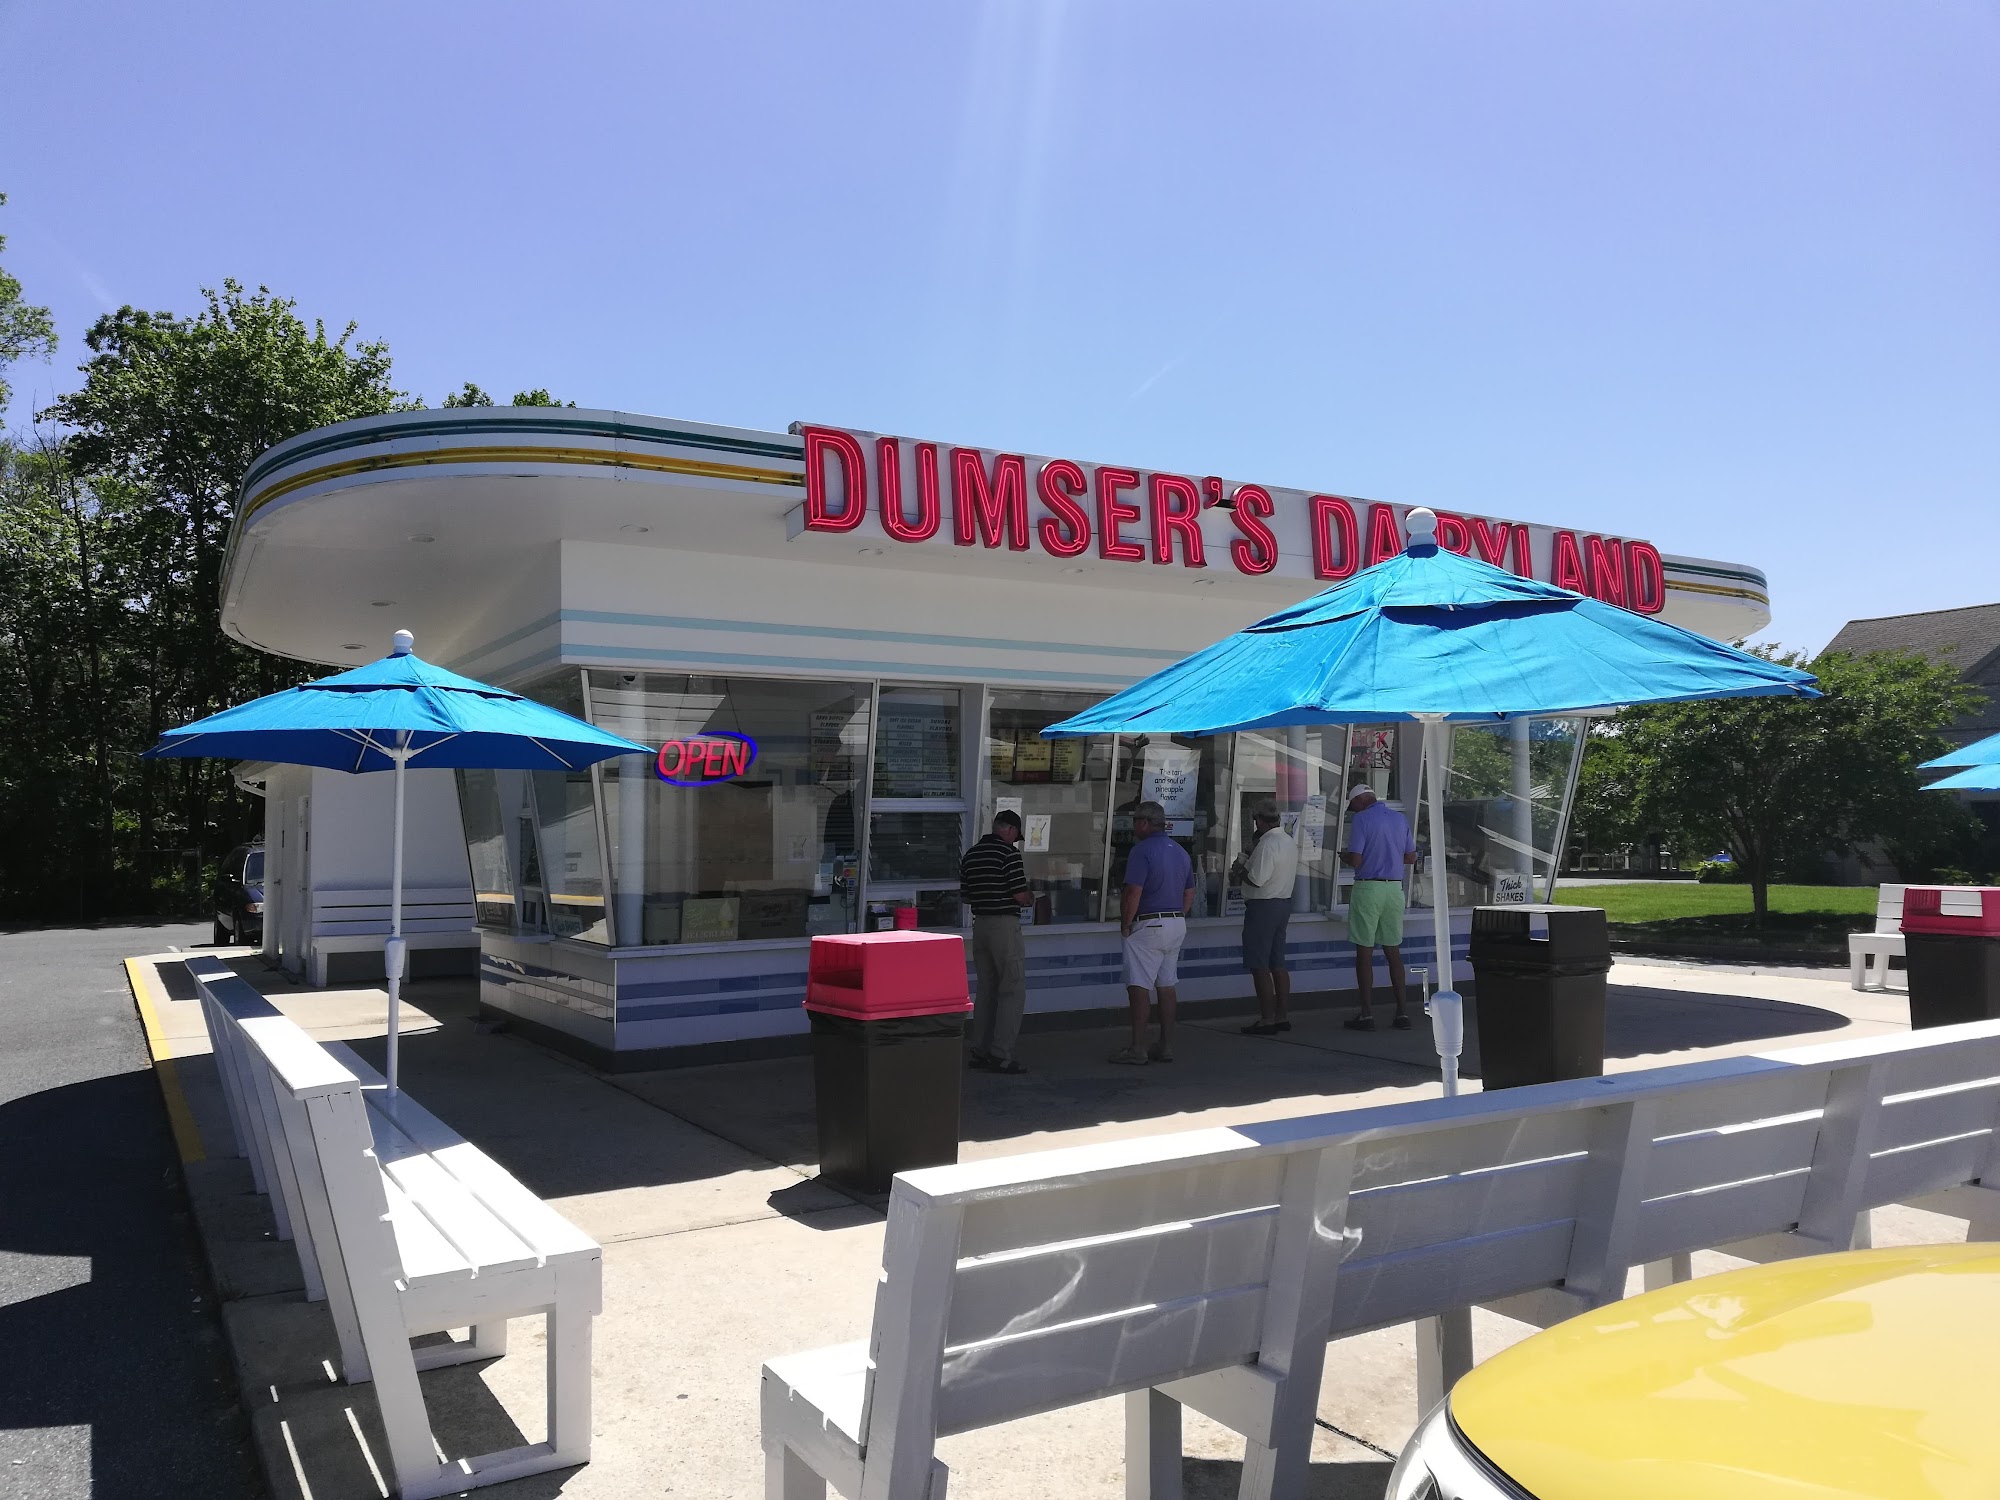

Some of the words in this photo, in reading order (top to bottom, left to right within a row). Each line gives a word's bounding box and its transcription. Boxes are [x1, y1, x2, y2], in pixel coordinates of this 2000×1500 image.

[804, 426, 1279, 576] DUMSER'S
[1309, 495, 1666, 615] DARYLAND
[657, 740, 748, 777] OPEN
[1495, 892, 1524, 902] SHAKES
[1500, 875, 1523, 892] Thick
